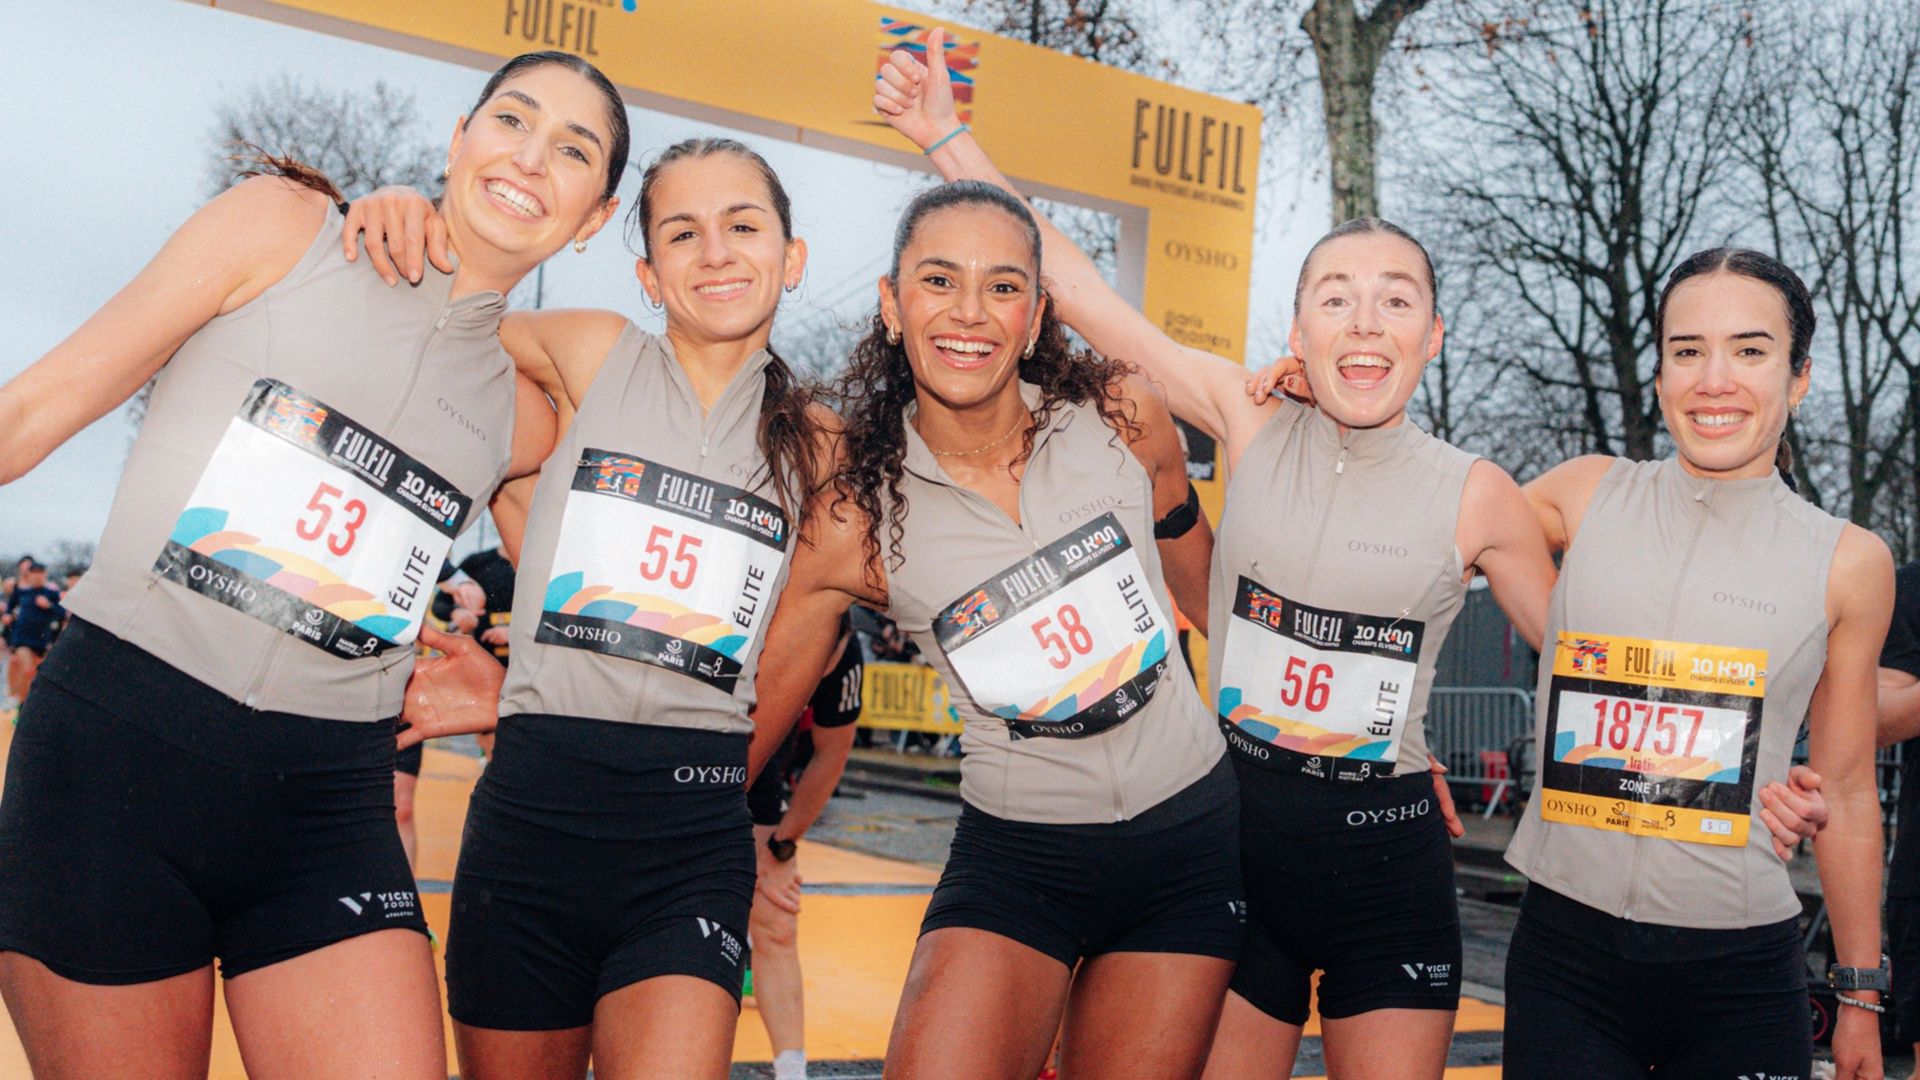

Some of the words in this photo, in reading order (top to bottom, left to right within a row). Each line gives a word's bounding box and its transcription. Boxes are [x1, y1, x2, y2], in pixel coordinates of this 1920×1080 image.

[504, 0, 599, 56] FULFIL
[1132, 98, 1246, 195] FULFIL
[1163, 239, 1239, 271] OYSHO
[437, 397, 487, 443] OYSHO
[333, 425, 397, 483] FULFIL
[400, 470, 426, 496] 10
[657, 472, 715, 514] FULFIL
[295, 480, 368, 558] 53
[726, 499, 749, 518] 10
[1058, 495, 1116, 525] OYSHO
[639, 524, 704, 590] 55
[1060, 544, 1083, 565] 10
[1347, 539, 1408, 558] OYSHO
[189, 563, 257, 603] OYSHO
[387, 544, 431, 613] ÉLITE
[1002, 555, 1058, 603] FULFIL
[732, 564, 765, 629] ÉLITE
[1116, 573, 1155, 634] ÉLITE
[1712, 590, 1777, 617] OYSHO
[292, 621, 323, 641] PARIS
[564, 624, 622, 645] OYSHO
[1030, 603, 1093, 670] 58
[1294, 608, 1343, 642] FULFIL
[1354, 625, 1375, 640] 10
[657, 652, 685, 668] PARIS
[1624, 646, 1676, 677] FULFIL
[1691, 657, 1713, 675] 10
[1280, 655, 1334, 713] 56
[1117, 699, 1138, 717] PARIS
[1366, 680, 1400, 737] ÉLITE
[1031, 722, 1084, 735] OYSHO
[1594, 698, 1705, 759] 18757
[1229, 732, 1270, 761] OYSHO
[673, 765, 746, 784] OYSHO
[1301, 766, 1325, 779] PARIS
[1619, 778, 1651, 795] ZONE
[1655, 783, 1661, 796] 1
[1346, 799, 1430, 826] OYSHO
[1546, 799, 1597, 819] OYSHO
[1605, 817, 1629, 828] PARIS
[377, 891, 415, 902] VICKY
[384, 901, 415, 910] FOODS
[1426, 963, 1452, 973] VICKY
